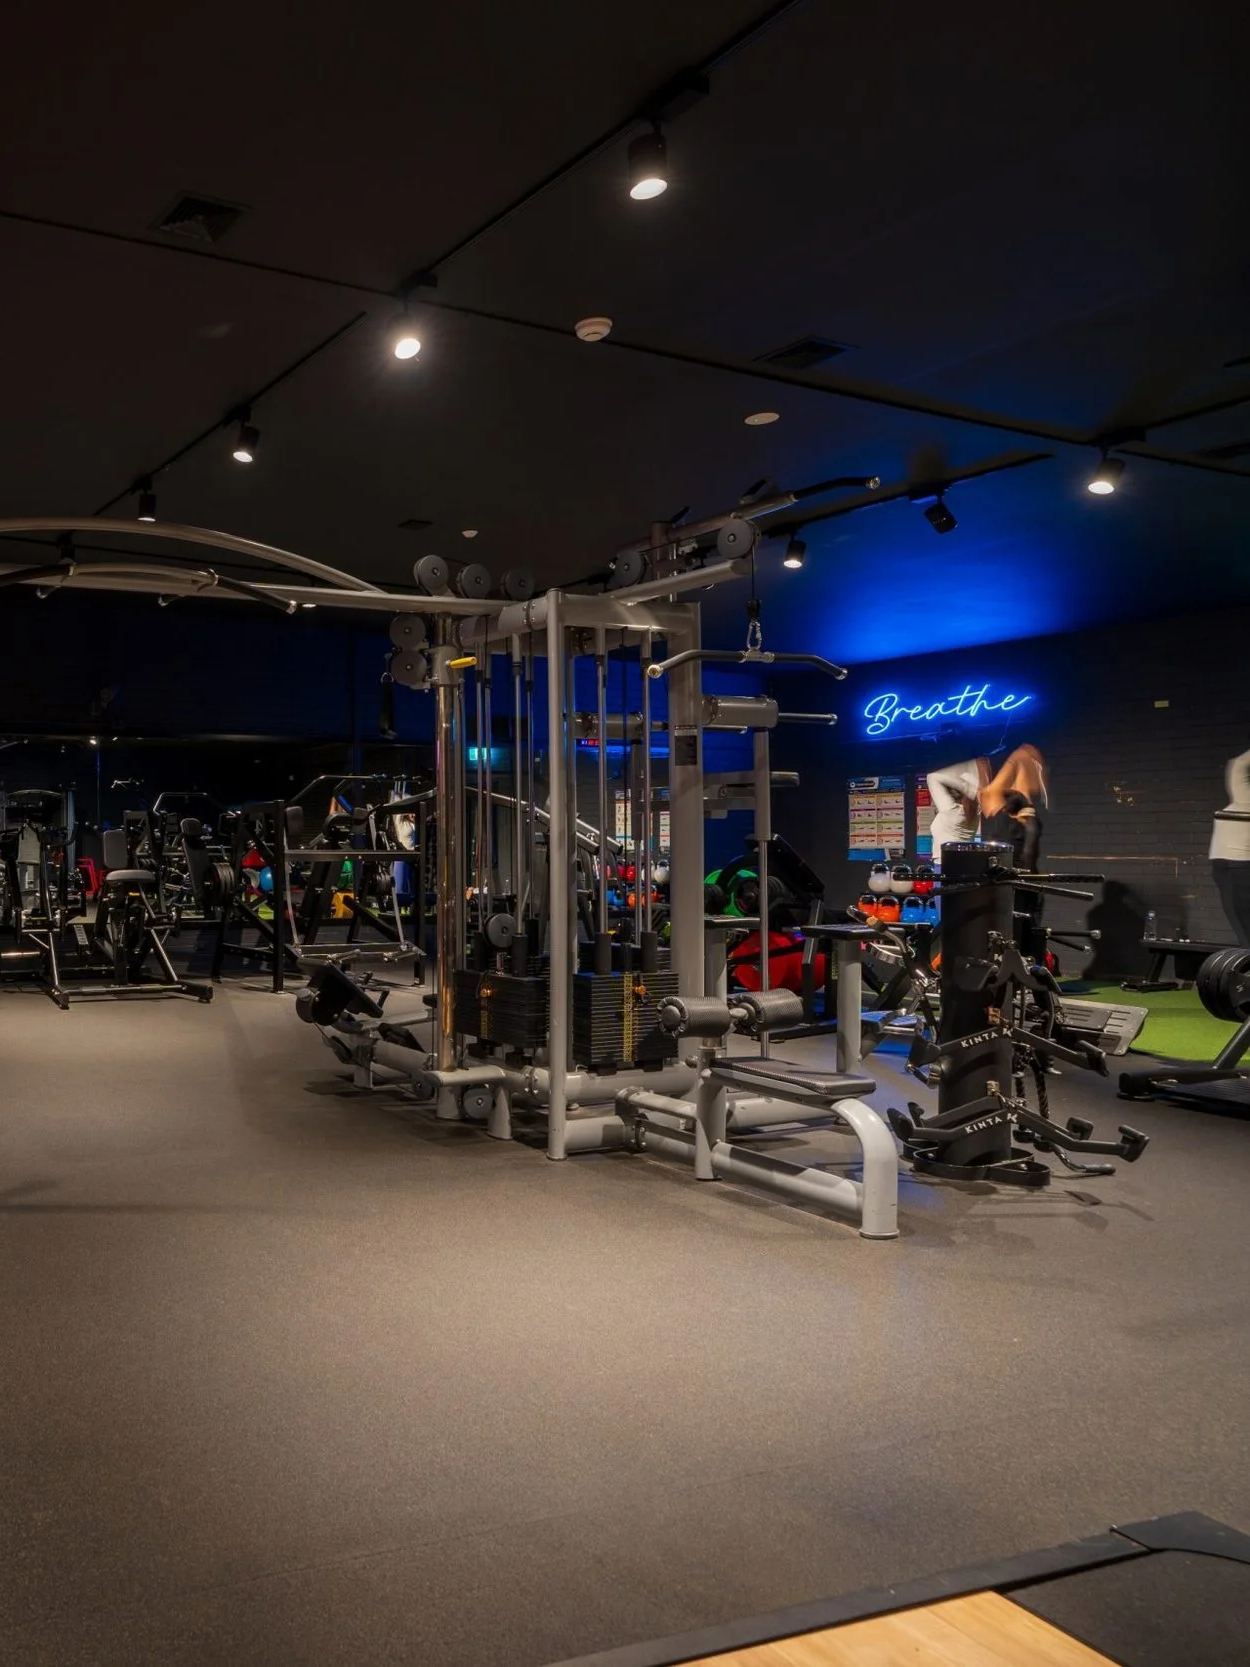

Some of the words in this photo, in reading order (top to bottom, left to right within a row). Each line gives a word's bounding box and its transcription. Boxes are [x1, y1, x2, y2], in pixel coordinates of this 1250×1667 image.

[864, 683, 1032, 735] Breathe
[961, 1032, 998, 1047] KINTA
[965, 1117, 1002, 1133] KINTA
